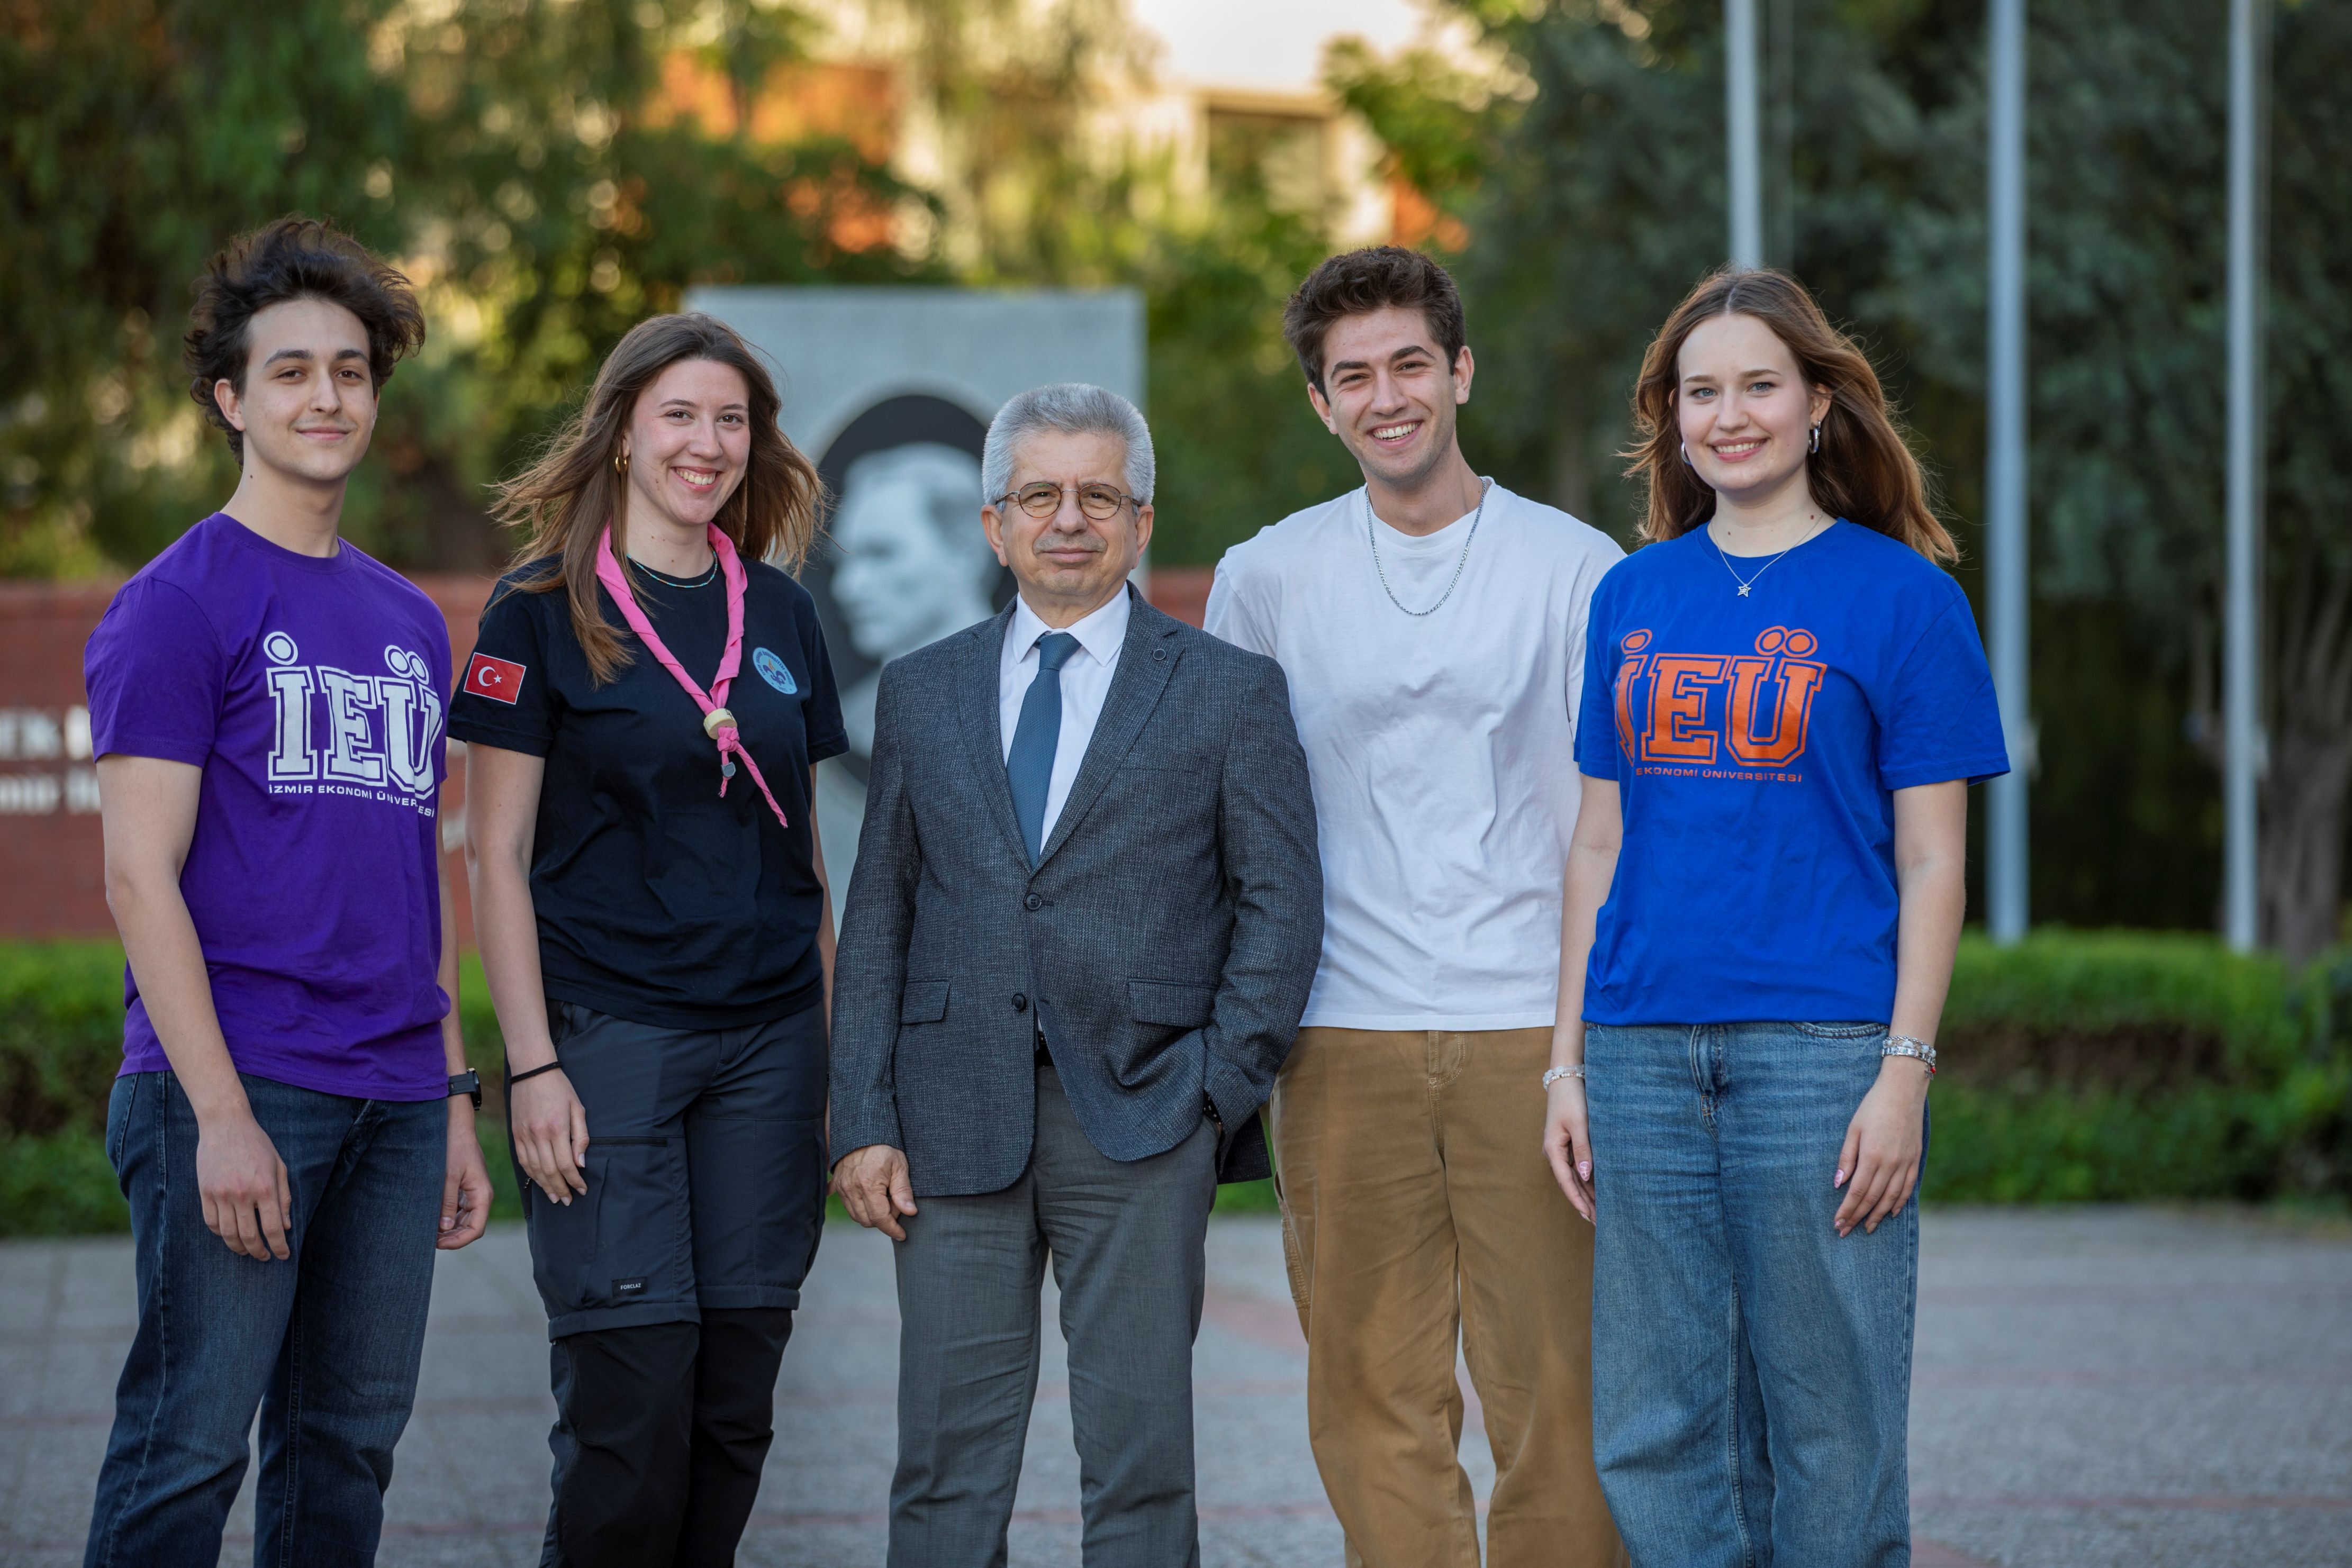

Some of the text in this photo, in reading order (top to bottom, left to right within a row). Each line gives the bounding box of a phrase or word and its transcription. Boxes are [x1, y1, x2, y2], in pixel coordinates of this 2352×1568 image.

[263, 631, 442, 800] İEÜ
[1614, 625, 1828, 767] İEÜ
[269, 784, 435, 818] İZMİR EKONOMİ ÜNİVERESİ
[1635, 767, 1802, 782] EKONOMİ ÜNİVERSİTESİ
